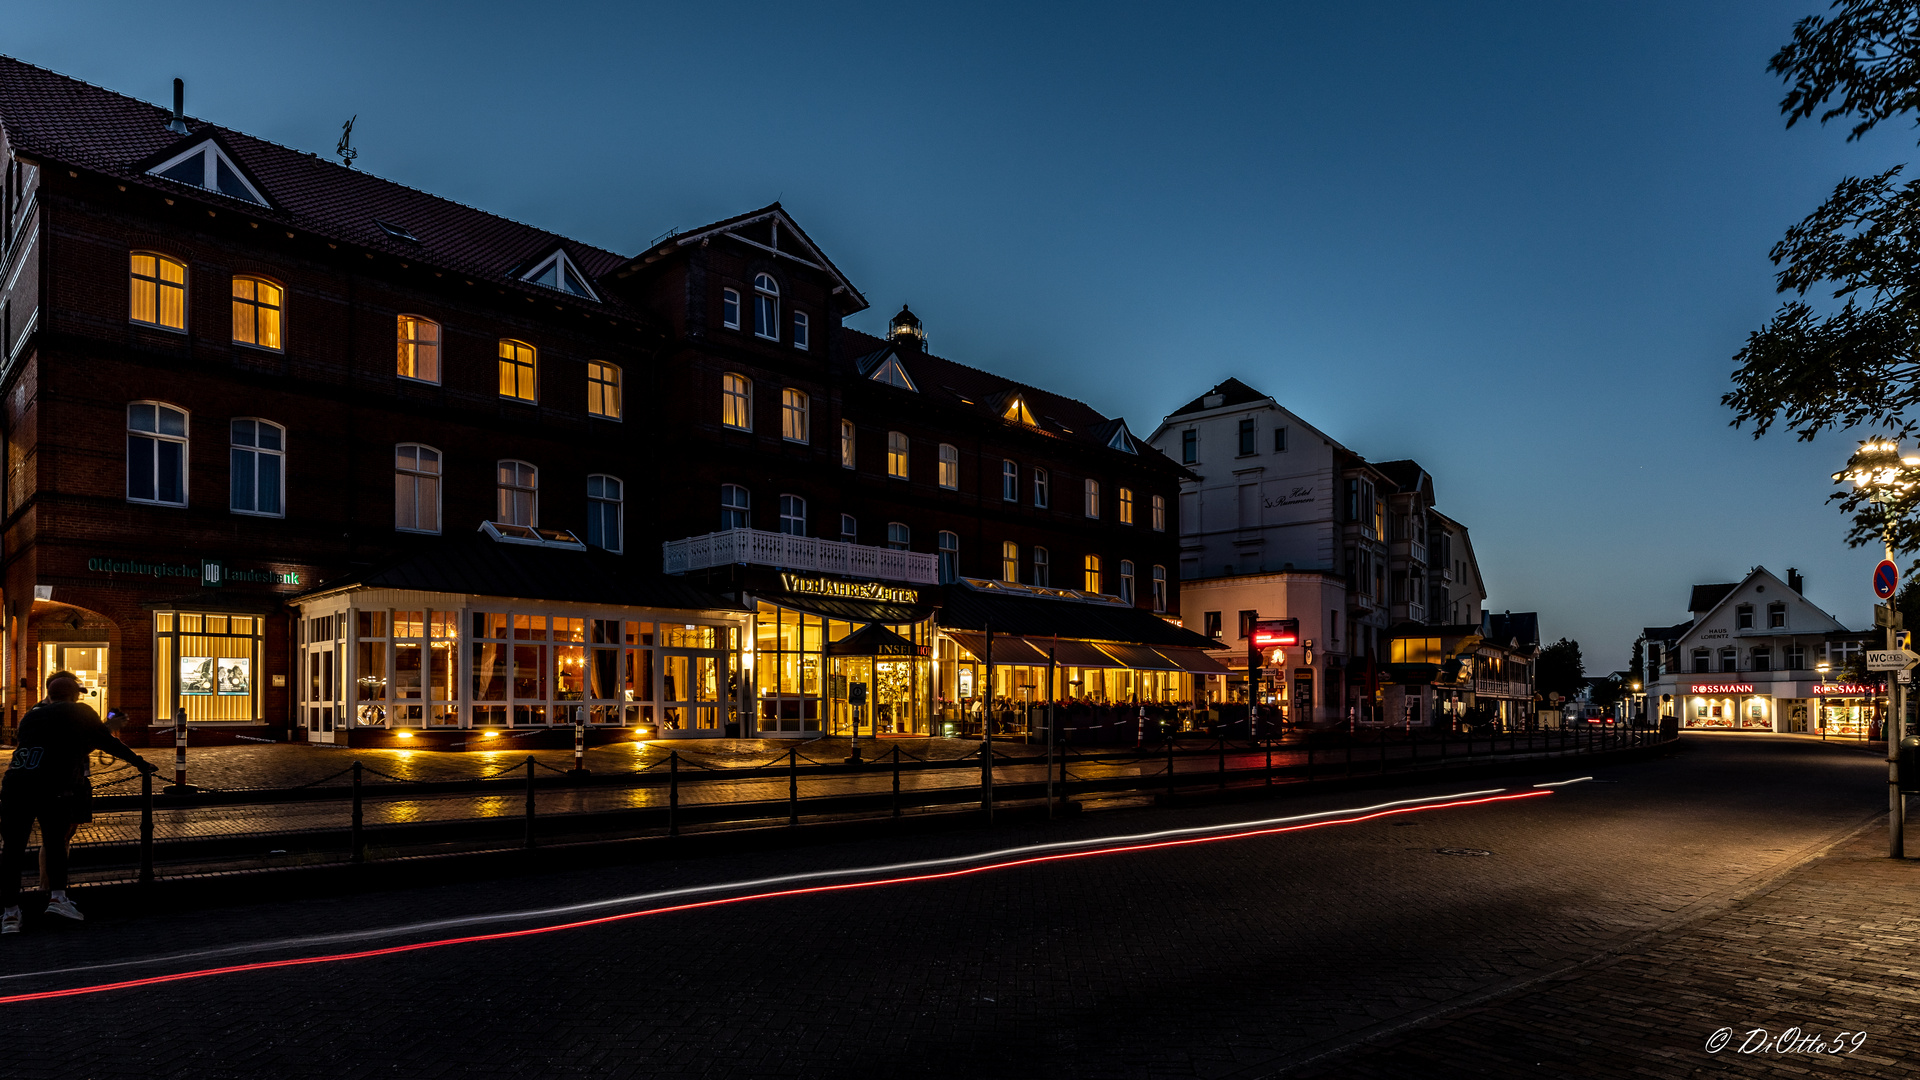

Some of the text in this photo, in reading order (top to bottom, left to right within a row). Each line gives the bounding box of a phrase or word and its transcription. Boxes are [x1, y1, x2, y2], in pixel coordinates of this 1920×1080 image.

[1289, 487, 1313, 498] Hotel
[88, 557, 199, 578] Oldenburgische
[224, 567, 300, 585] Landesbank
[878, 644, 913, 655] INSEL
[1869, 653, 1887, 662] WC
[1692, 684, 1753, 694] ROSSMANN
